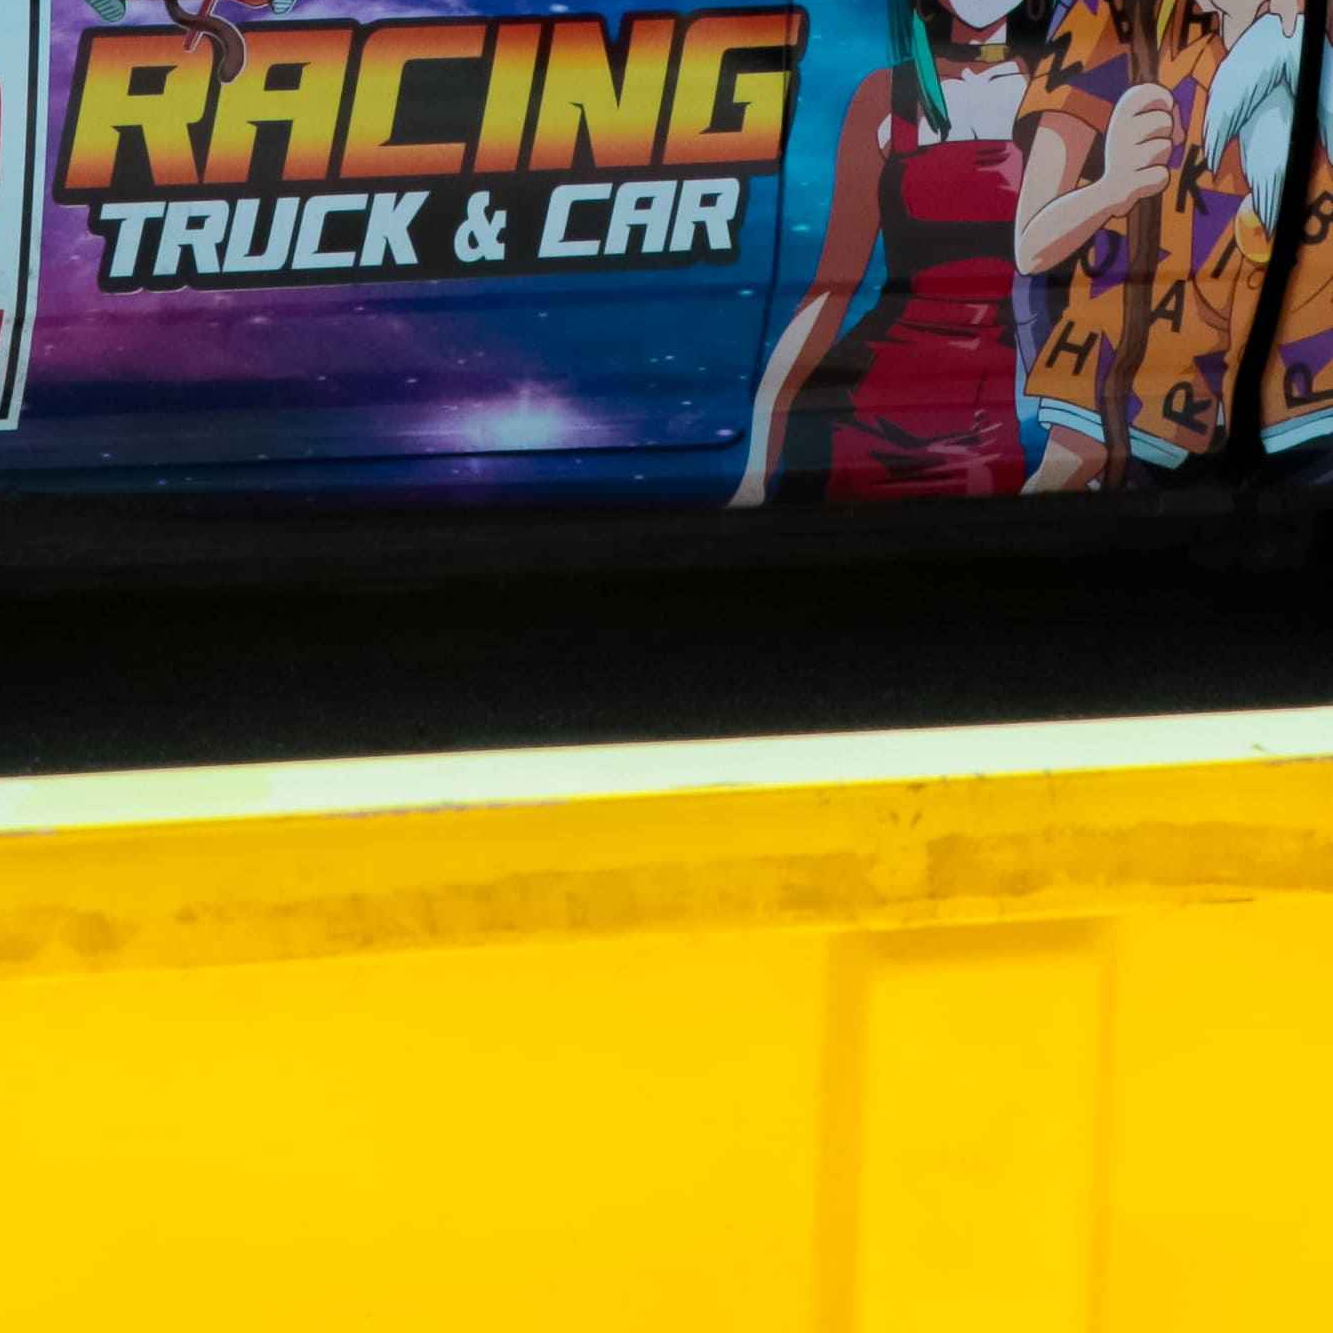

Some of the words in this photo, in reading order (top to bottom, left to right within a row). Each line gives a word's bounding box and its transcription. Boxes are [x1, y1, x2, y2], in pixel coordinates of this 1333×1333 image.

[63, 13, 805, 190] RACING
[99, 190, 431, 279] TRUCK
[453, 190, 509, 264] &
[537, 177, 741, 259] CAR
